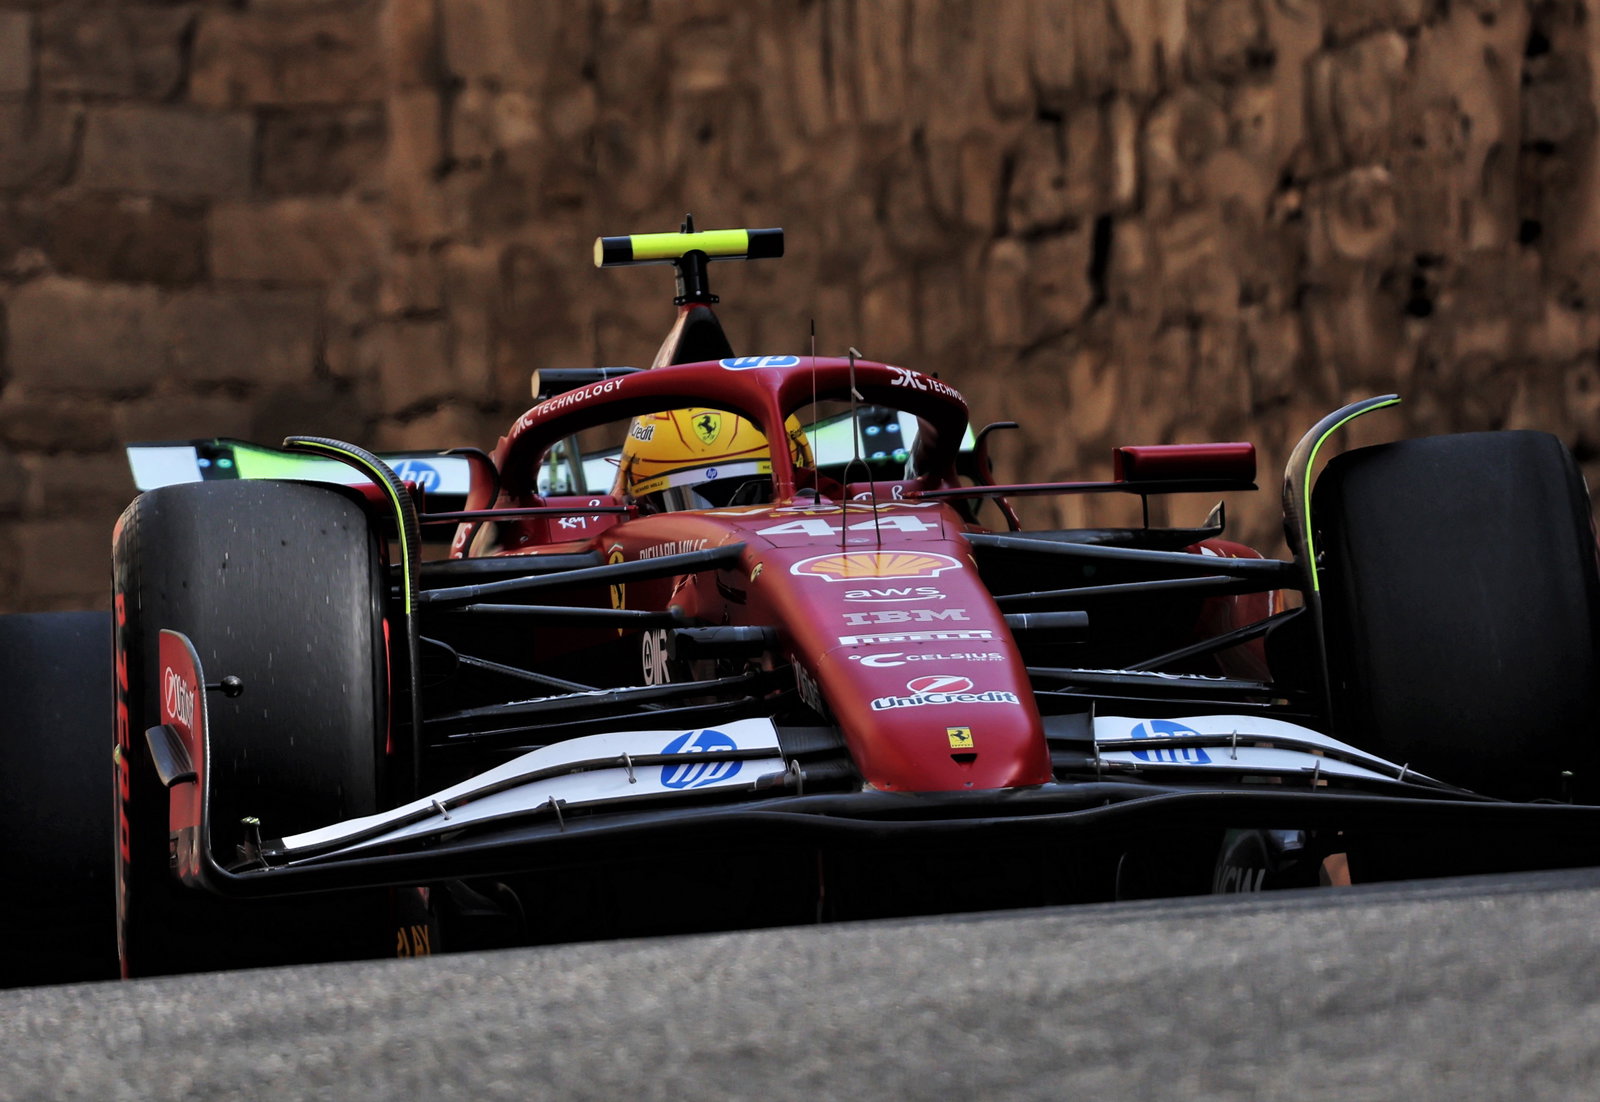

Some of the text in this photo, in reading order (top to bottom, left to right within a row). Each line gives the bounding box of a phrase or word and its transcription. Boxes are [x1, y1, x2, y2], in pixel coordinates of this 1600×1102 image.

[536, 378, 624, 416] TECHNOLOGY
[756, 515, 938, 537] 44
[844, 587, 942, 600] aws
[842, 608, 970, 626] IBM
[906, 652, 1002, 661] CELSIUS
[873, 691, 1018, 710] UniCredit
[663, 730, 739, 789] hp
